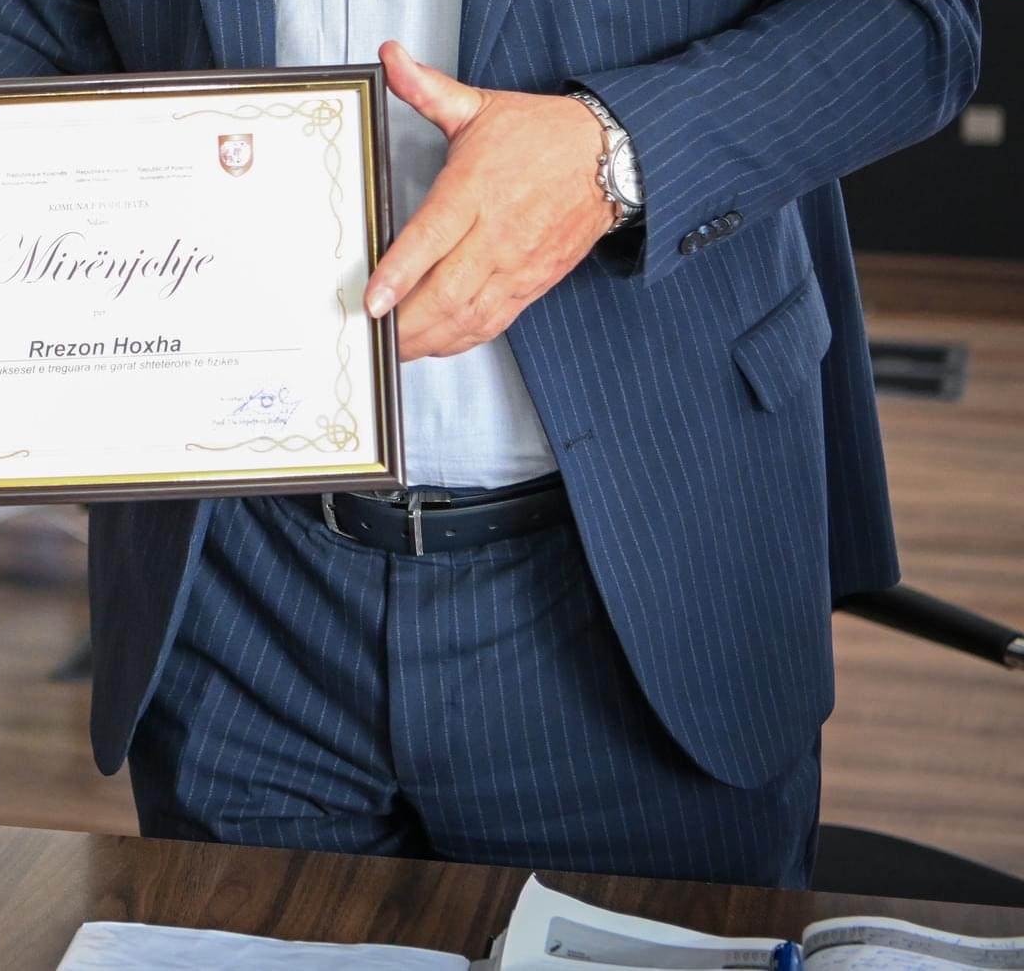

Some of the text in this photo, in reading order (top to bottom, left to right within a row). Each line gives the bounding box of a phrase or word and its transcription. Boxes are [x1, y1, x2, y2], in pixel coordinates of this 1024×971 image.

[28, 335, 182, 359] Rrezon Hoxha
[48, 363, 91, 375] treguara
[110, 362, 137, 373] garat
